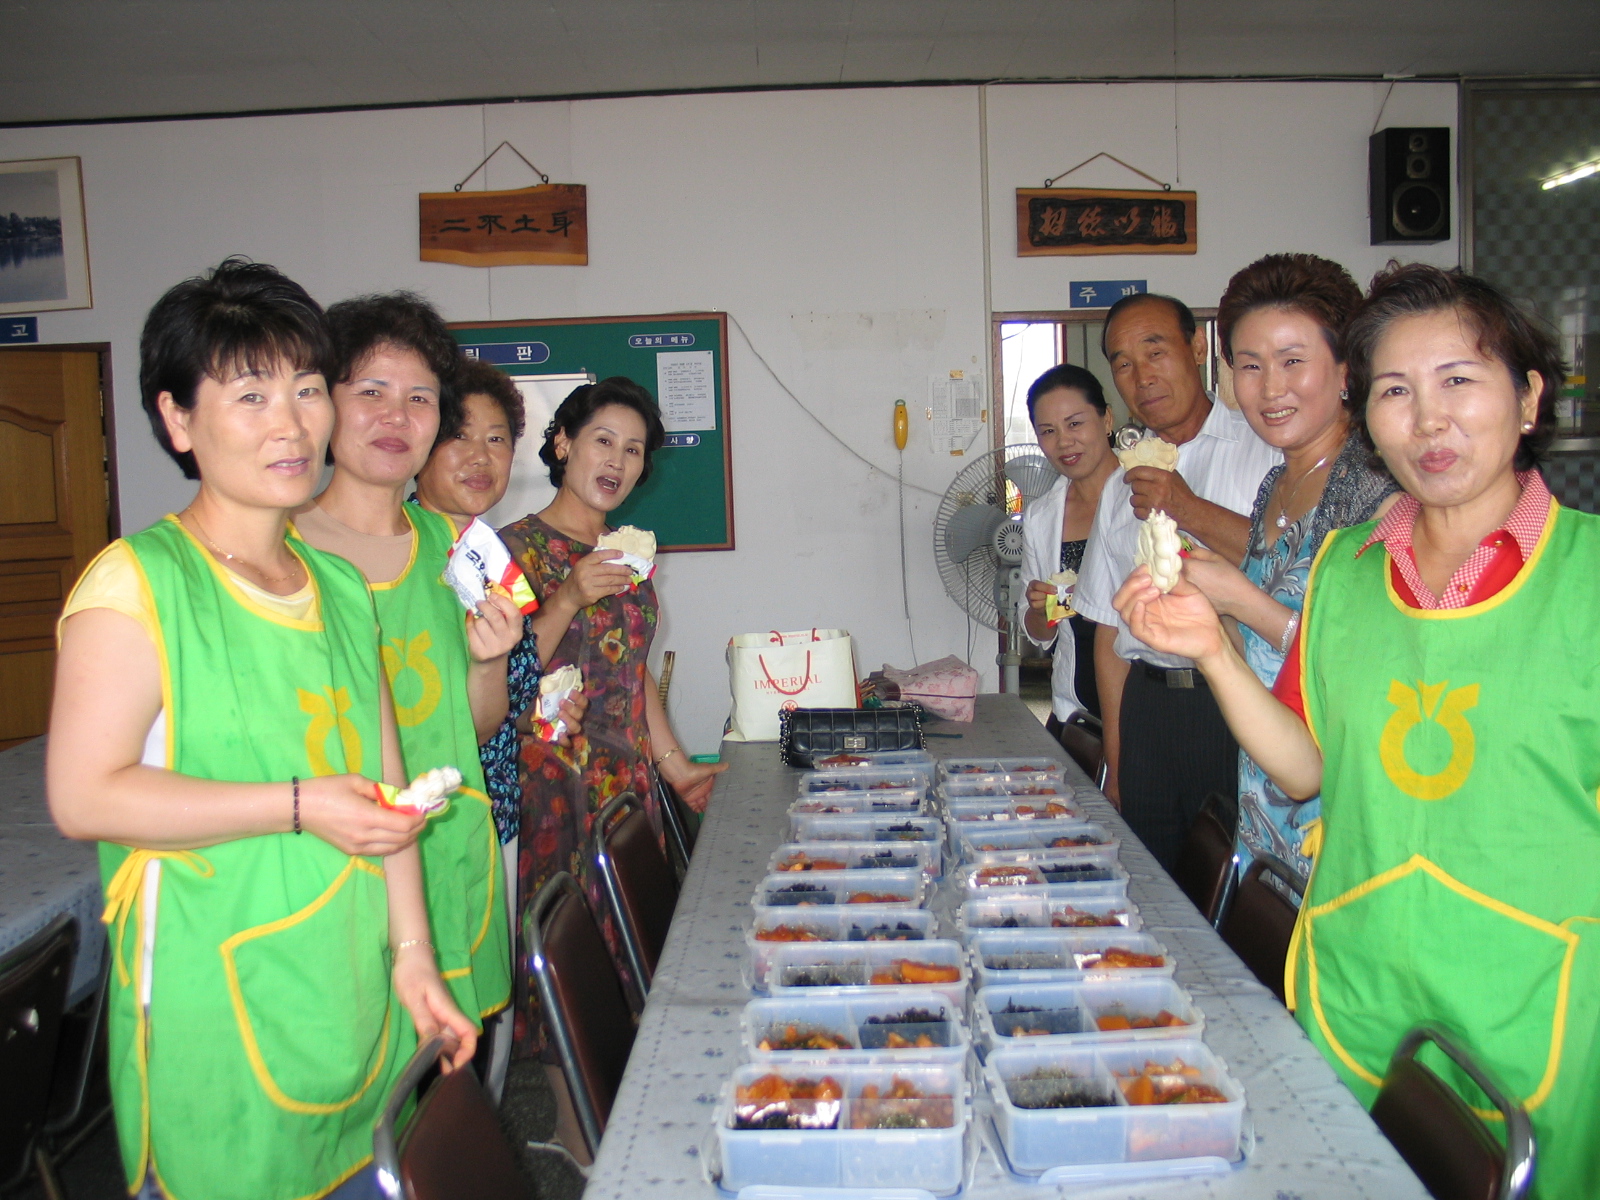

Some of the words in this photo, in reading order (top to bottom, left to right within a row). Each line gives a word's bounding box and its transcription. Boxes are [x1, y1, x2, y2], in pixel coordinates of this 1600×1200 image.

[634, 336, 663, 346] 오늘의
[670, 335, 689, 345] 메뉴
[464, 345, 533, 361] 림판
[670, 435, 695, 445] 사항
[753, 673, 823, 690] IMPERIAL
